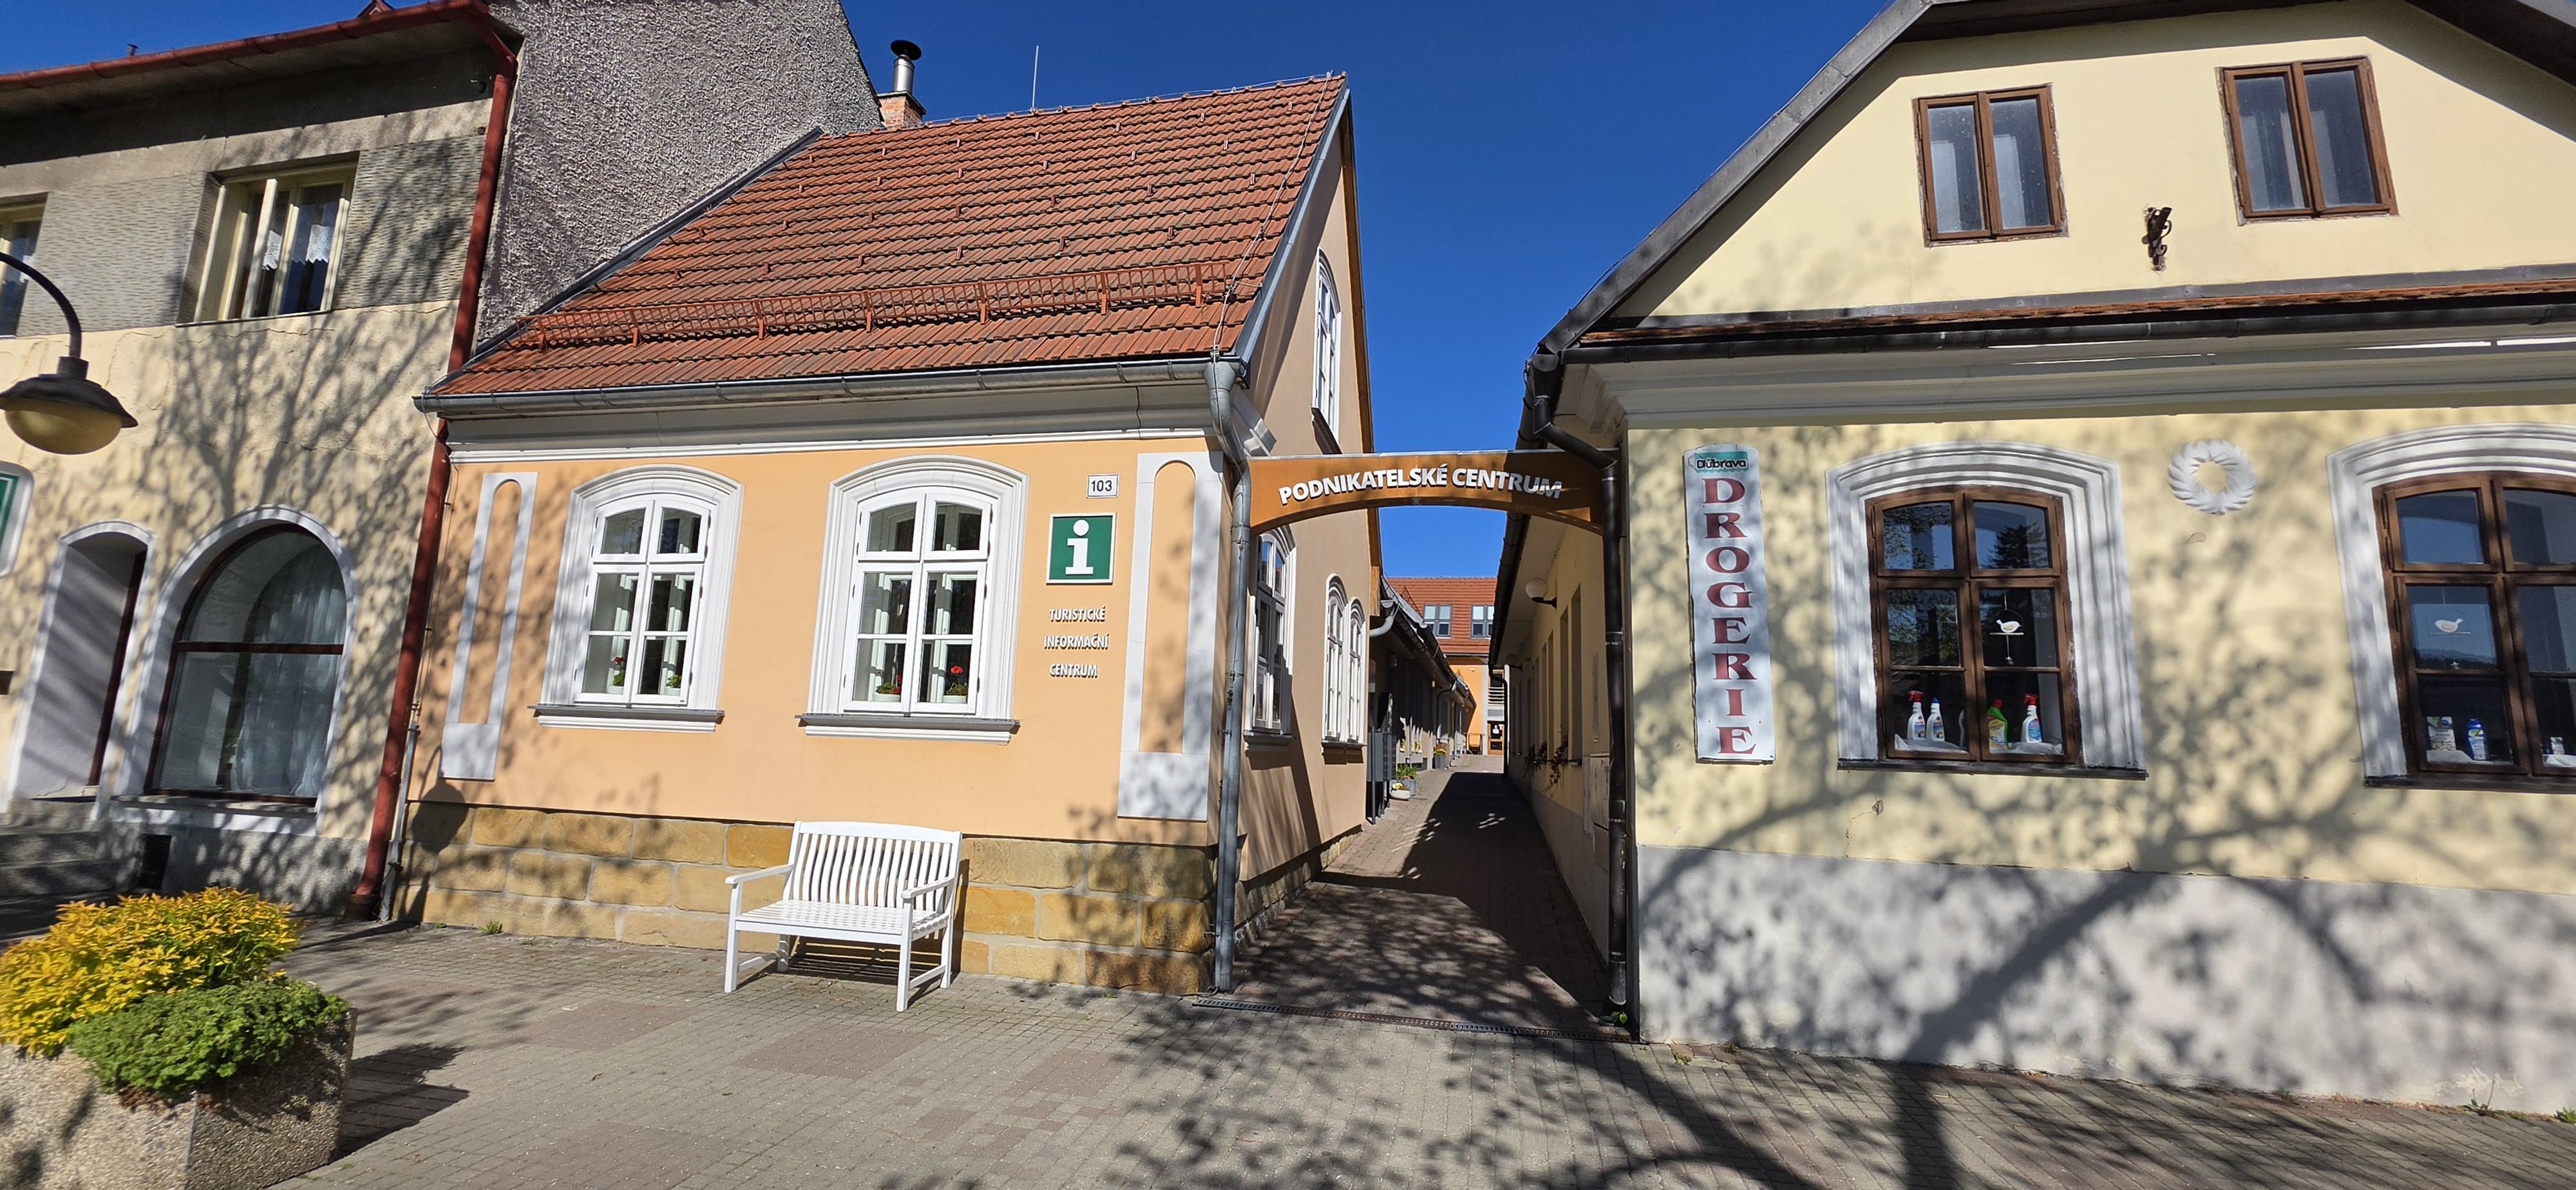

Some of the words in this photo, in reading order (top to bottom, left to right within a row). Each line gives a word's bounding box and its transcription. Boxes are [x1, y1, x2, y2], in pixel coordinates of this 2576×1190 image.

[1091, 480, 1113, 492] 103
[1278, 464, 1448, 505] PODNIKATELSKÉ
[1452, 468, 1562, 499] CENTRUM
[1049, 606, 1106, 623] TURISTICKÉ
[1702, 478, 1757, 754] DROGERIE
[1044, 634, 1110, 650] INFORMAČNÍ
[1049, 664, 1098, 678] CENTRUM
